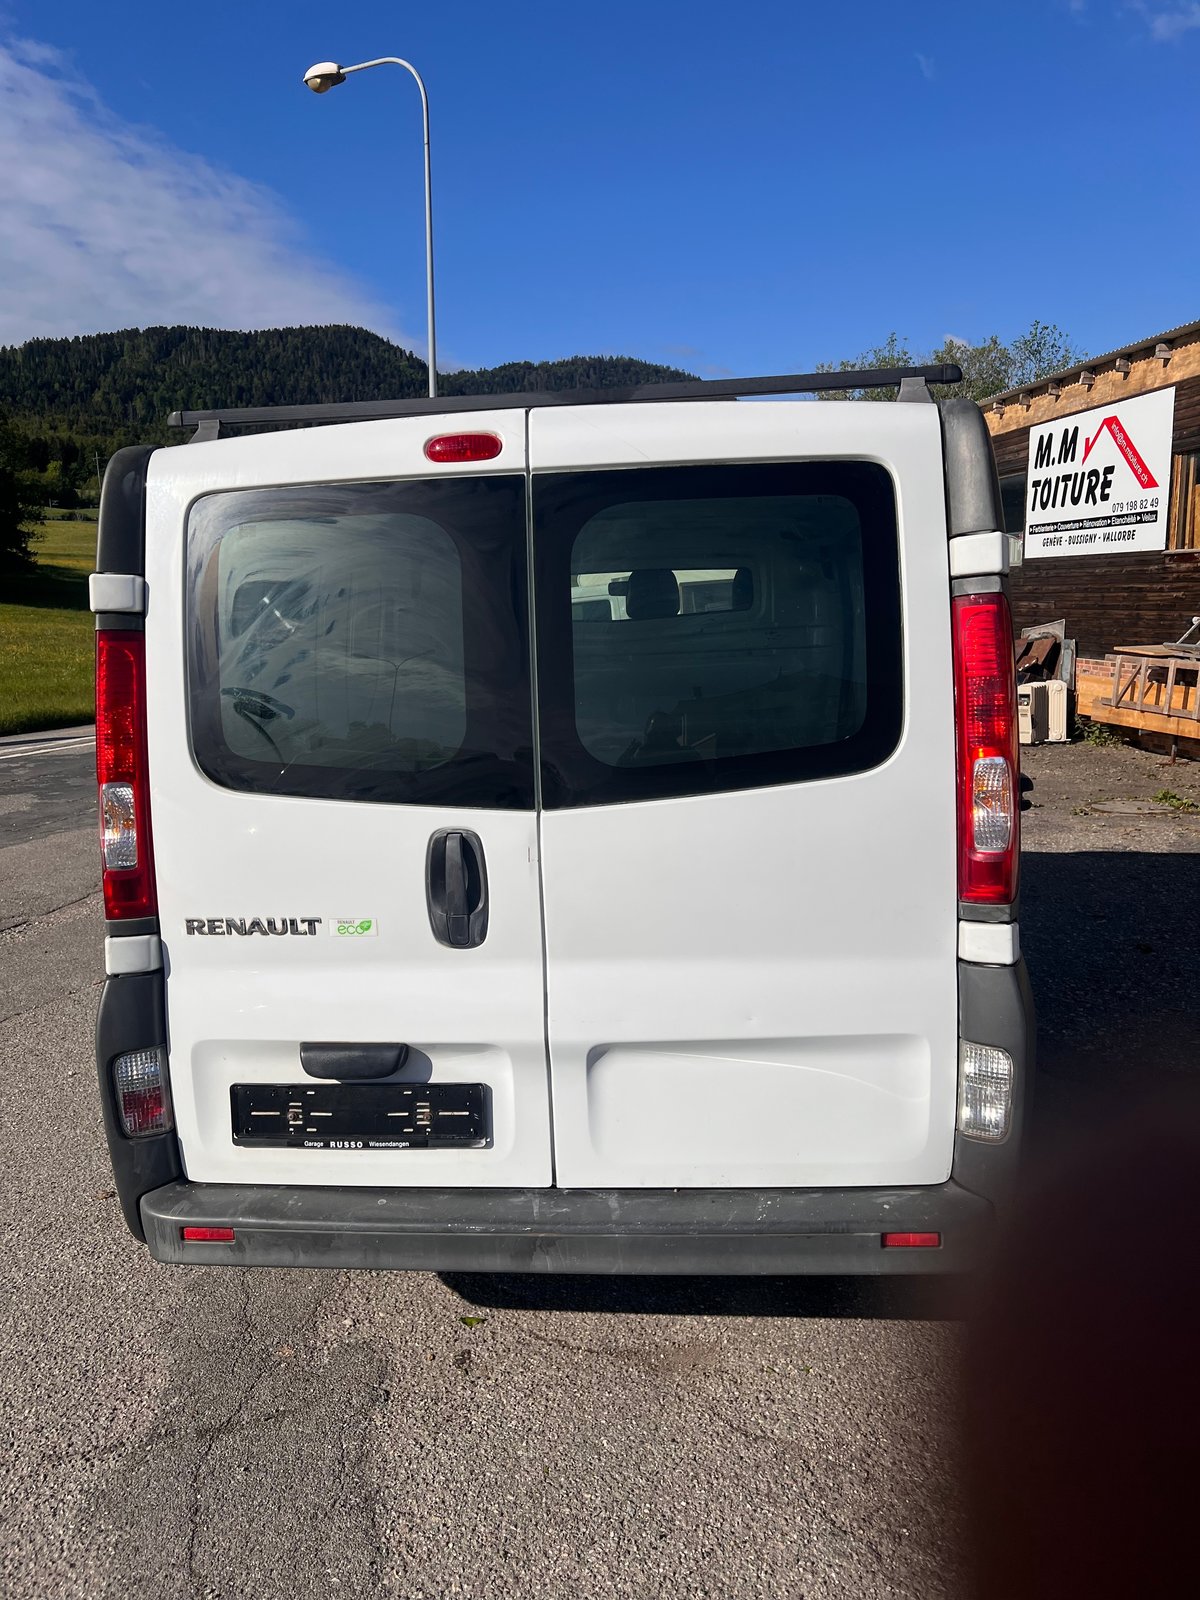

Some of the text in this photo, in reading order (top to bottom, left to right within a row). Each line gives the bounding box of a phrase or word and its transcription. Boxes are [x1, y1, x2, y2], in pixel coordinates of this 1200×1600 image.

[1034, 426, 1079, 470] M.M
[1031, 465, 1116, 512] TOITURE
[1112, 497, 1159, 513] 079 198 82 49
[1057, 521, 1080, 531] Couverture
[1082, 518, 1108, 529] Rénovation
[1042, 534, 1063, 547] GENÈVE
[1068, 533, 1097, 545] BUSSIGNY
[1102, 529, 1137, 543] VALLORBE
[185, 917, 322, 936] RENAULT
[337, 924, 365, 935] eco
[304, 1140, 324, 1148] Garage
[330, 1141, 363, 1149] RUSSO
